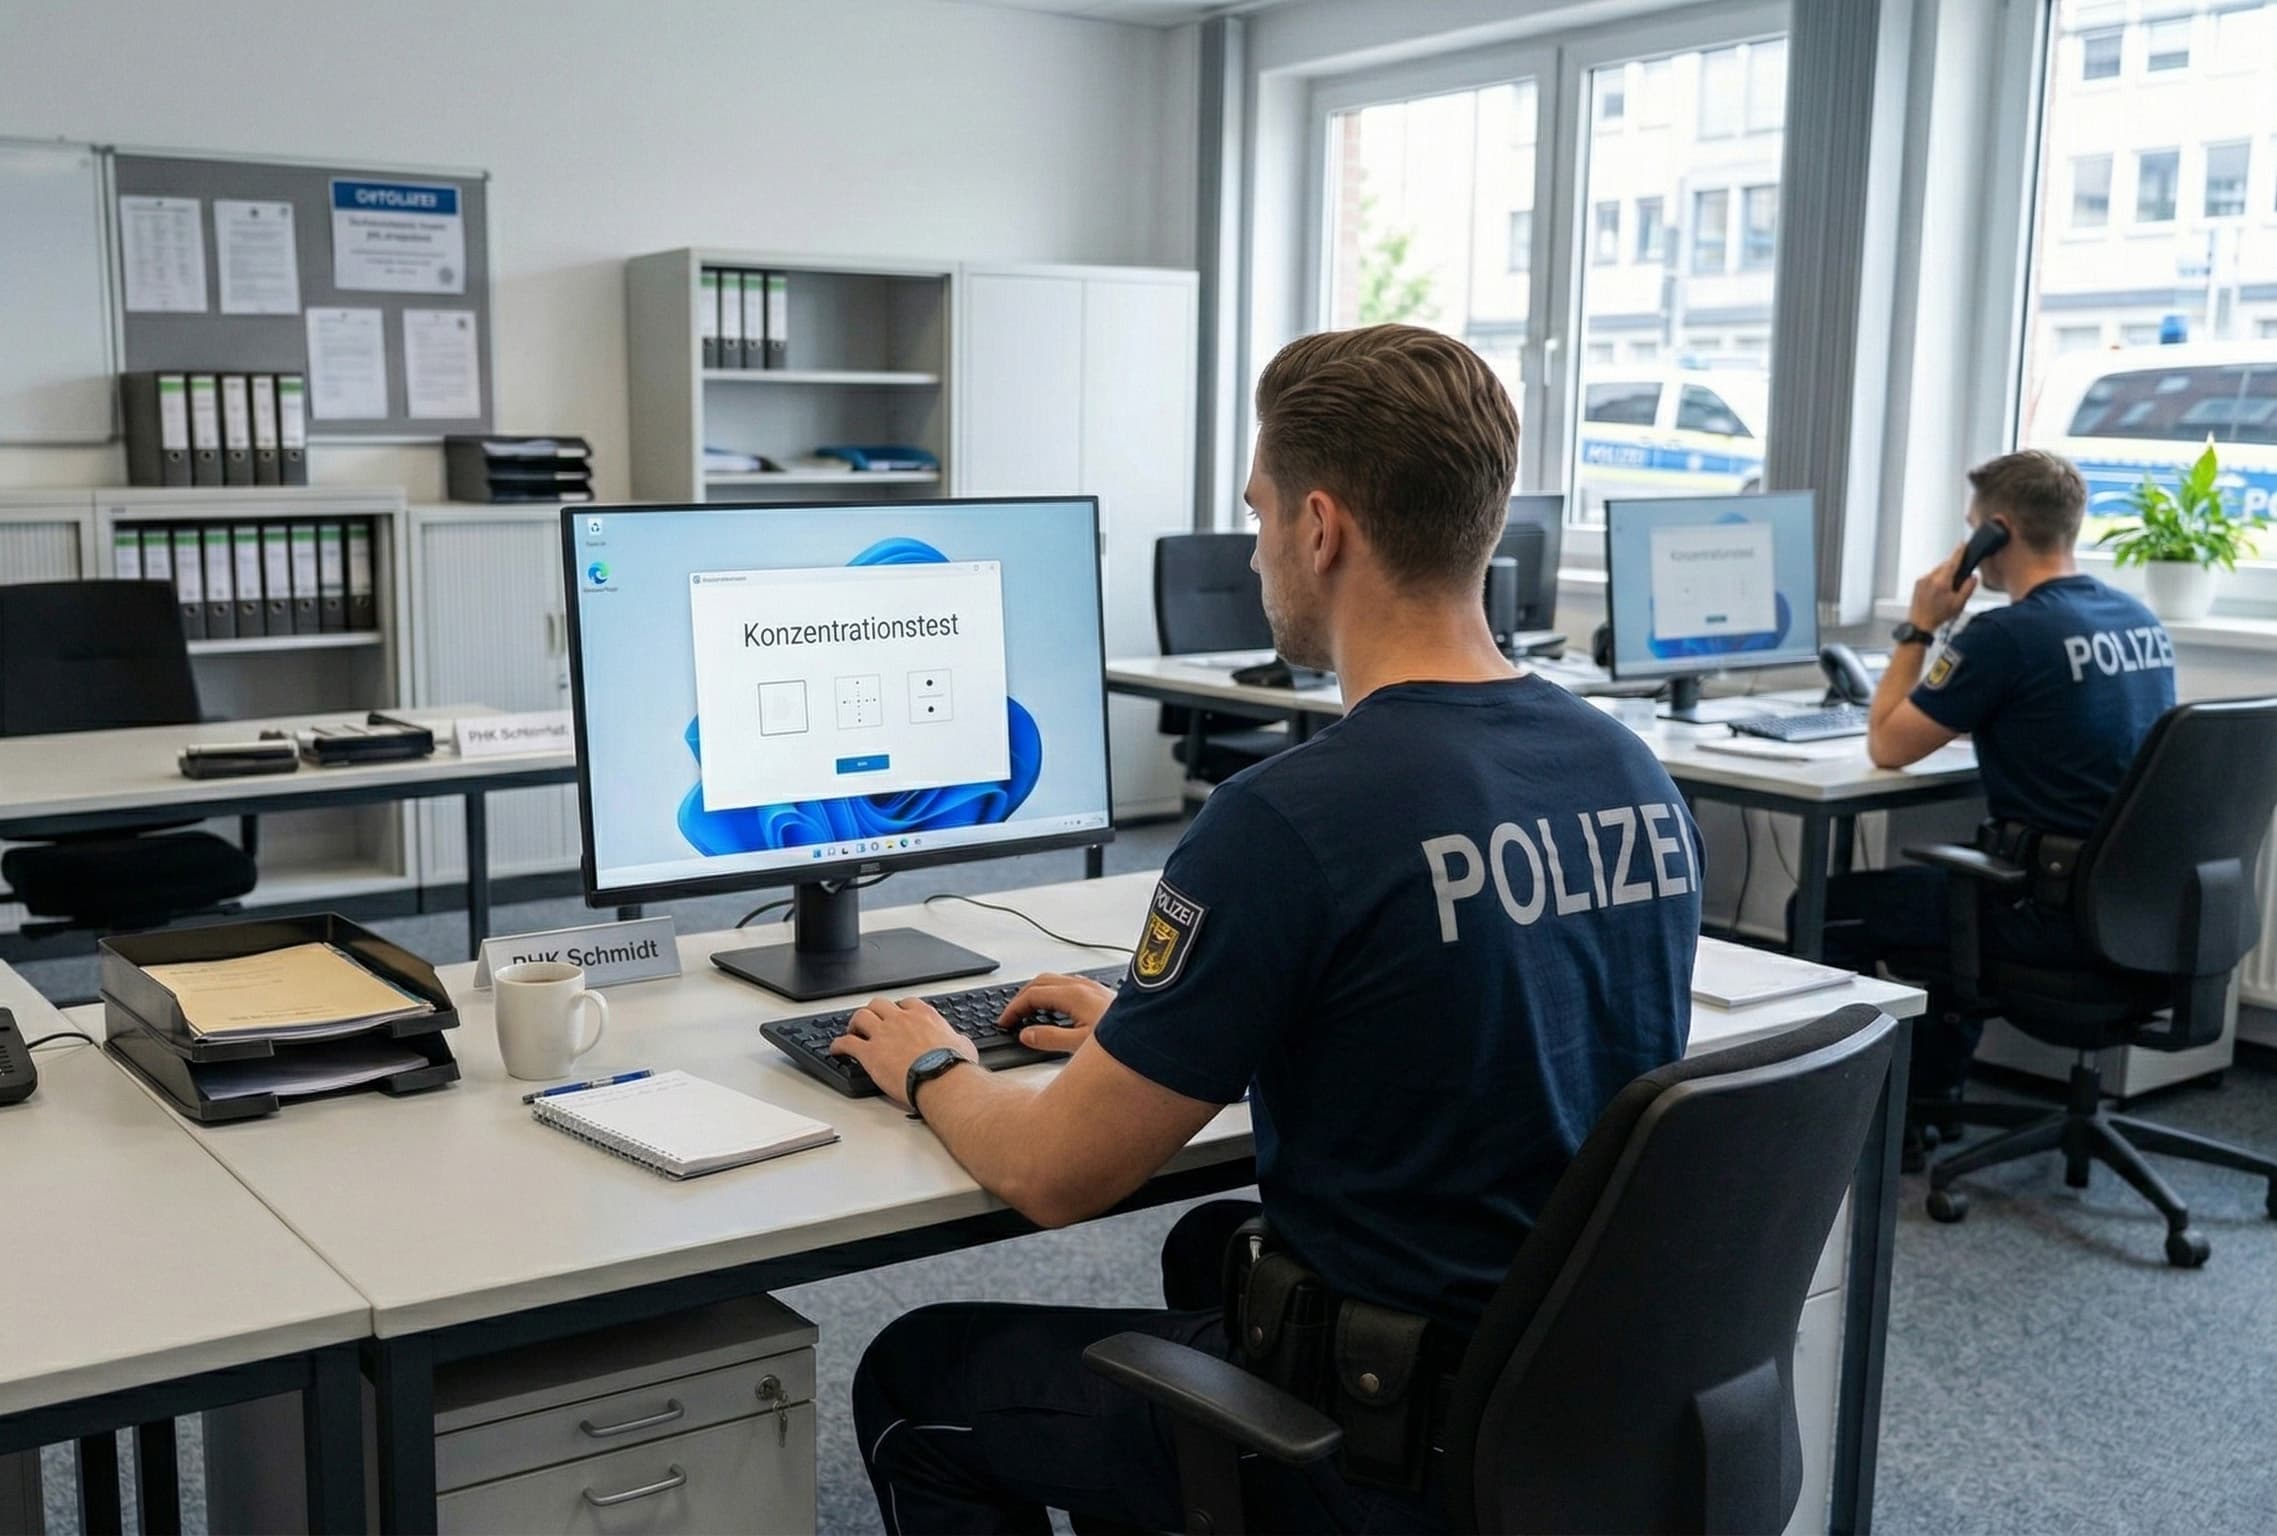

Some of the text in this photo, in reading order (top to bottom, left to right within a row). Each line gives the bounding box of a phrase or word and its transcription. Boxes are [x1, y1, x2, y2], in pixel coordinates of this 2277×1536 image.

[744, 613, 959, 648] Konzentrationstest
[2063, 625, 2176, 683] POLIZE
[1421, 802, 1697, 944] POLIZEI
[567, 939, 660, 968] Schmidt
